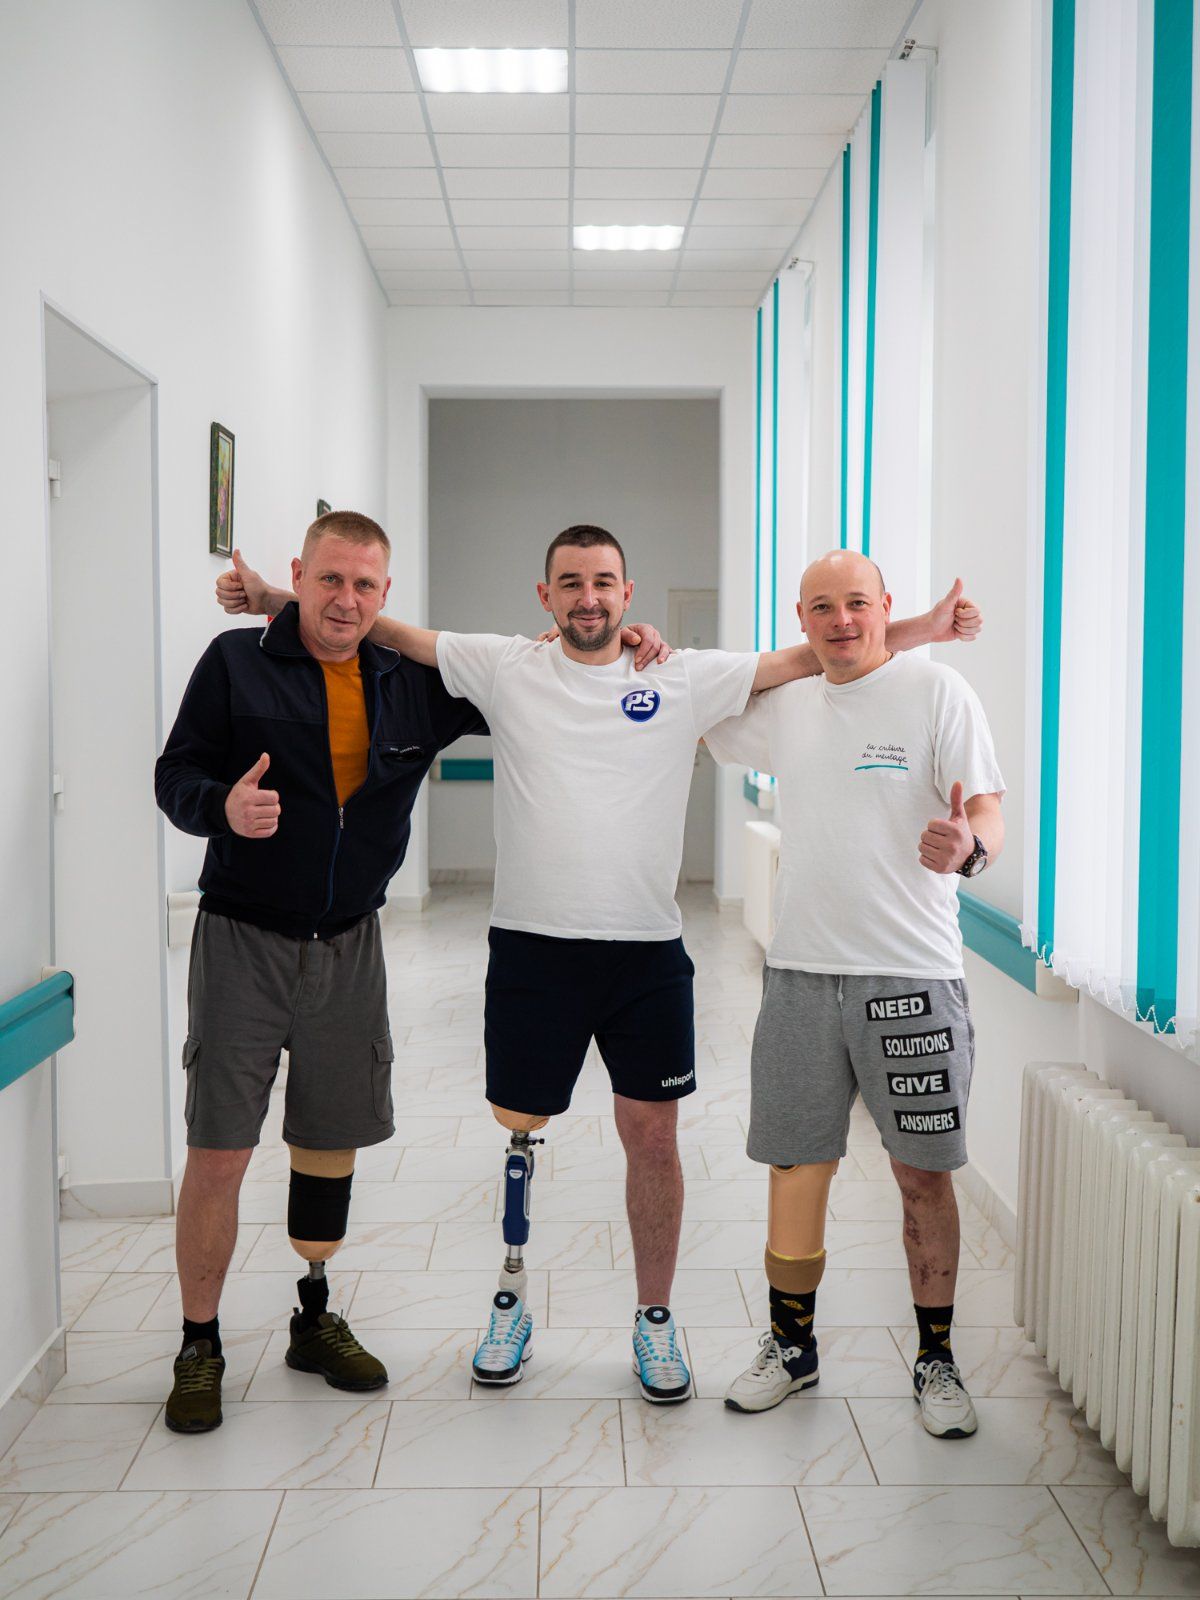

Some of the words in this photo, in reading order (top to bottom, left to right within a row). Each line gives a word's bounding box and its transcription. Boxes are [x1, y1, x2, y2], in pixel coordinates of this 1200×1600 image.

[865, 743, 877, 751] la
[878, 743, 907, 753] culture
[869, 996, 925, 1019] NEED
[884, 1031, 950, 1057] SOLUTIONS
[661, 1068, 694, 1088] uhlsport
[891, 1073, 944, 1095] GIVE
[900, 1111, 955, 1133] ANSWERS
